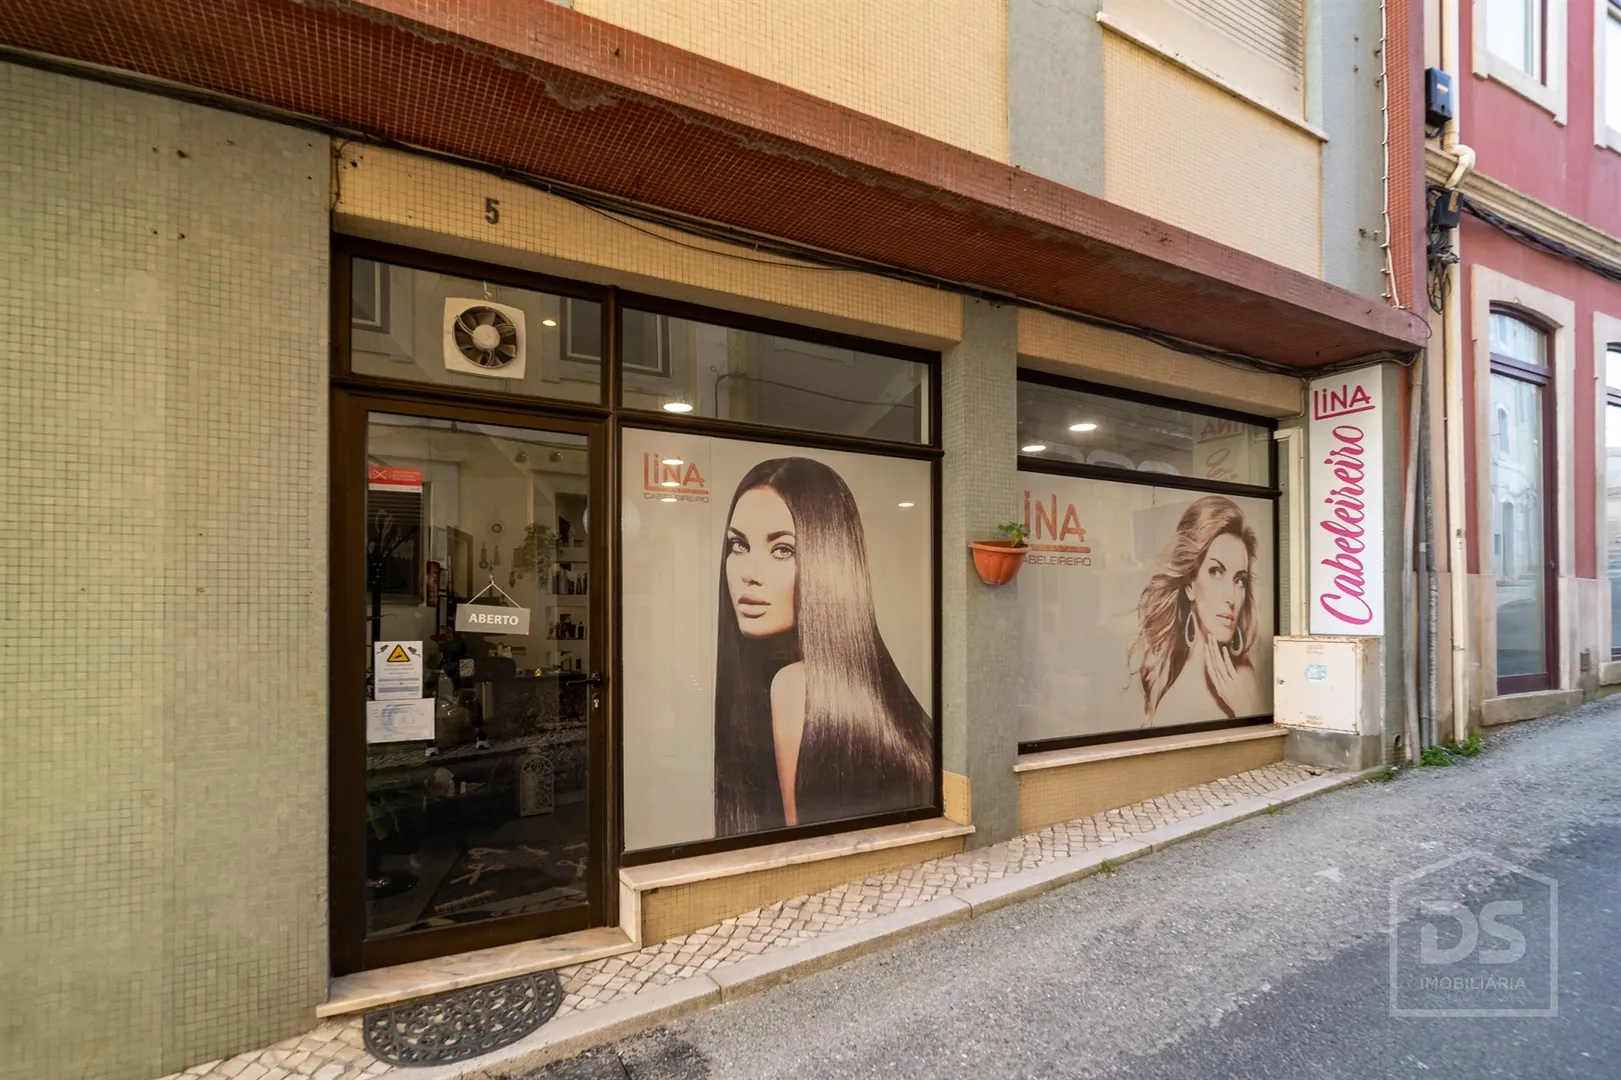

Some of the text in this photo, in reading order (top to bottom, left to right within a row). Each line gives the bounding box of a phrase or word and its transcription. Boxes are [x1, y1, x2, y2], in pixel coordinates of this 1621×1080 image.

[485, 197, 499, 225] 5
[1320, 425, 1373, 625] Cabeleireiro
[1022, 554, 1092, 567] ABELEIREIRO
[468, 613, 520, 626] ABERTO
